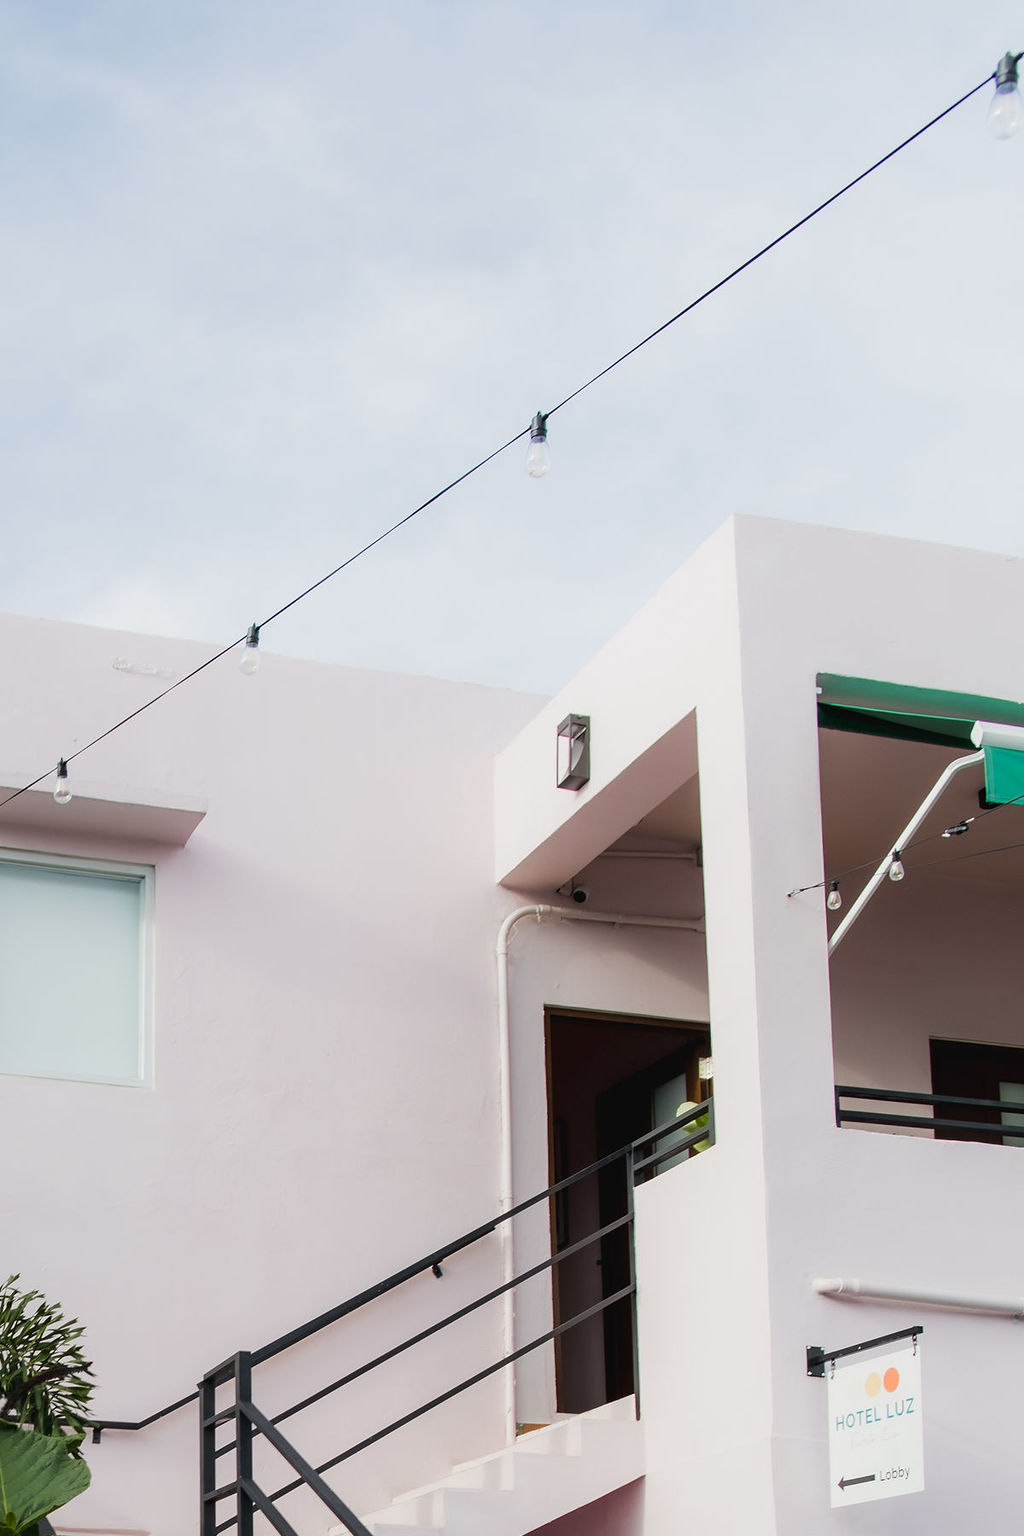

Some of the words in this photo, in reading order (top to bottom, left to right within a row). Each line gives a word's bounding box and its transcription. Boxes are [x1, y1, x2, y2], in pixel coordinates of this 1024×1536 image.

[836, 1406, 881, 1431] HOTEL
[886, 1397, 915, 1419] LUZ
[879, 1466, 911, 1481] Lobby
